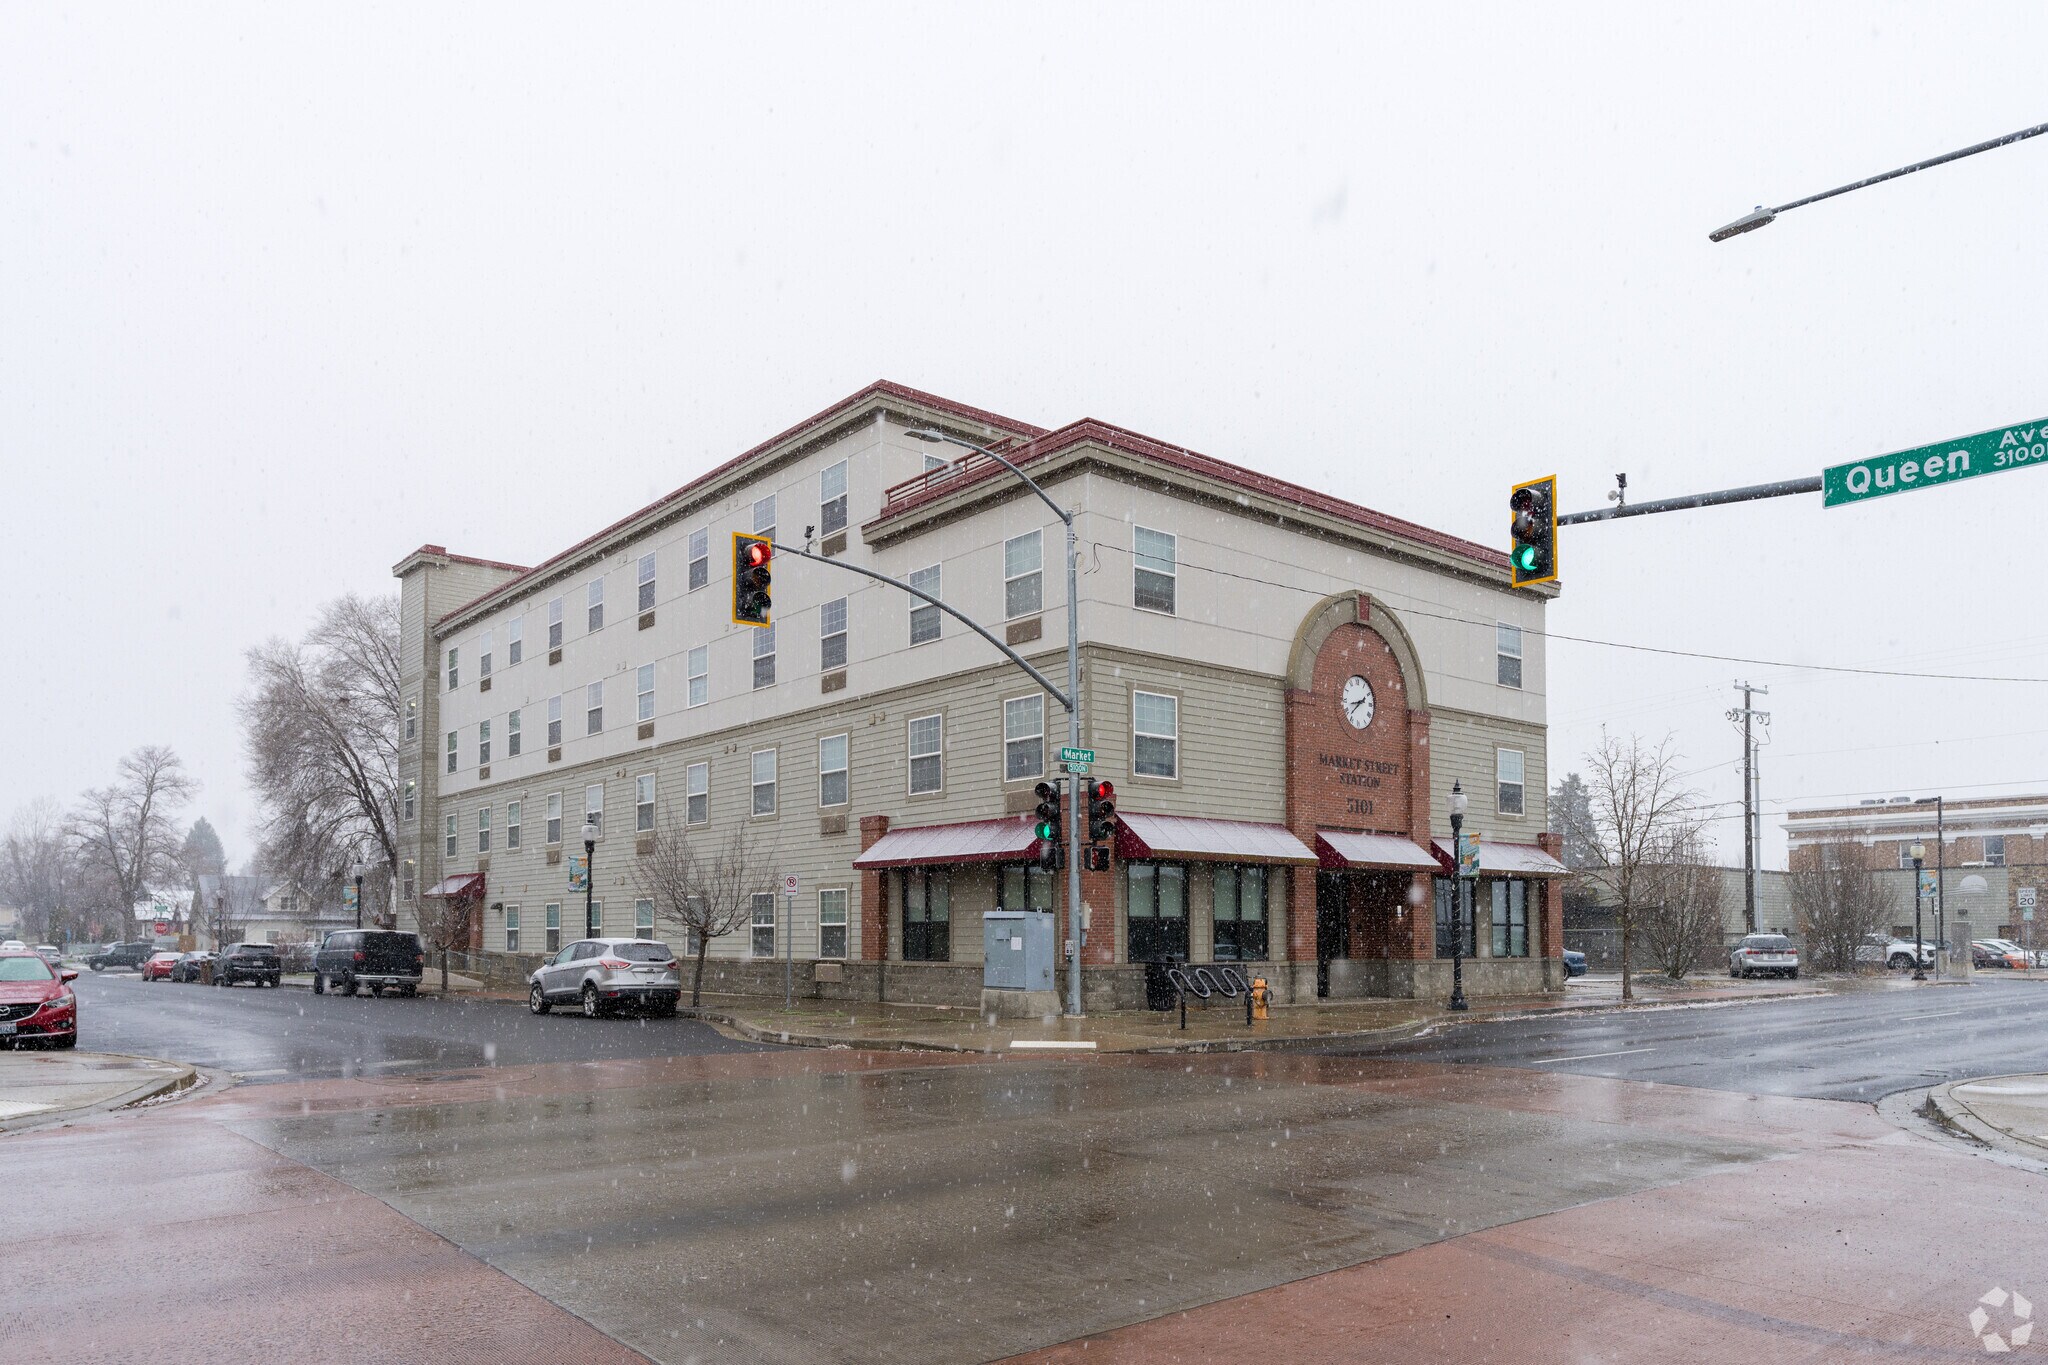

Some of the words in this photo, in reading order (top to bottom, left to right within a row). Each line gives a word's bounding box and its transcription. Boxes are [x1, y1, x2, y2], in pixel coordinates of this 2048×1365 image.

[1846, 449, 1970, 494] Queen
[1999, 425, 2048, 449] Ave
[1993, 442, 2048, 467] 3100
[1064, 749, 1091, 761] Market
[1319, 753, 1362, 770] MARKET
[1364, 760, 1400, 776] STREET
[1339, 772, 1381, 788] STATION
[1346, 797, 1374, 815] 5101
[2019, 897, 2035, 906] 20
